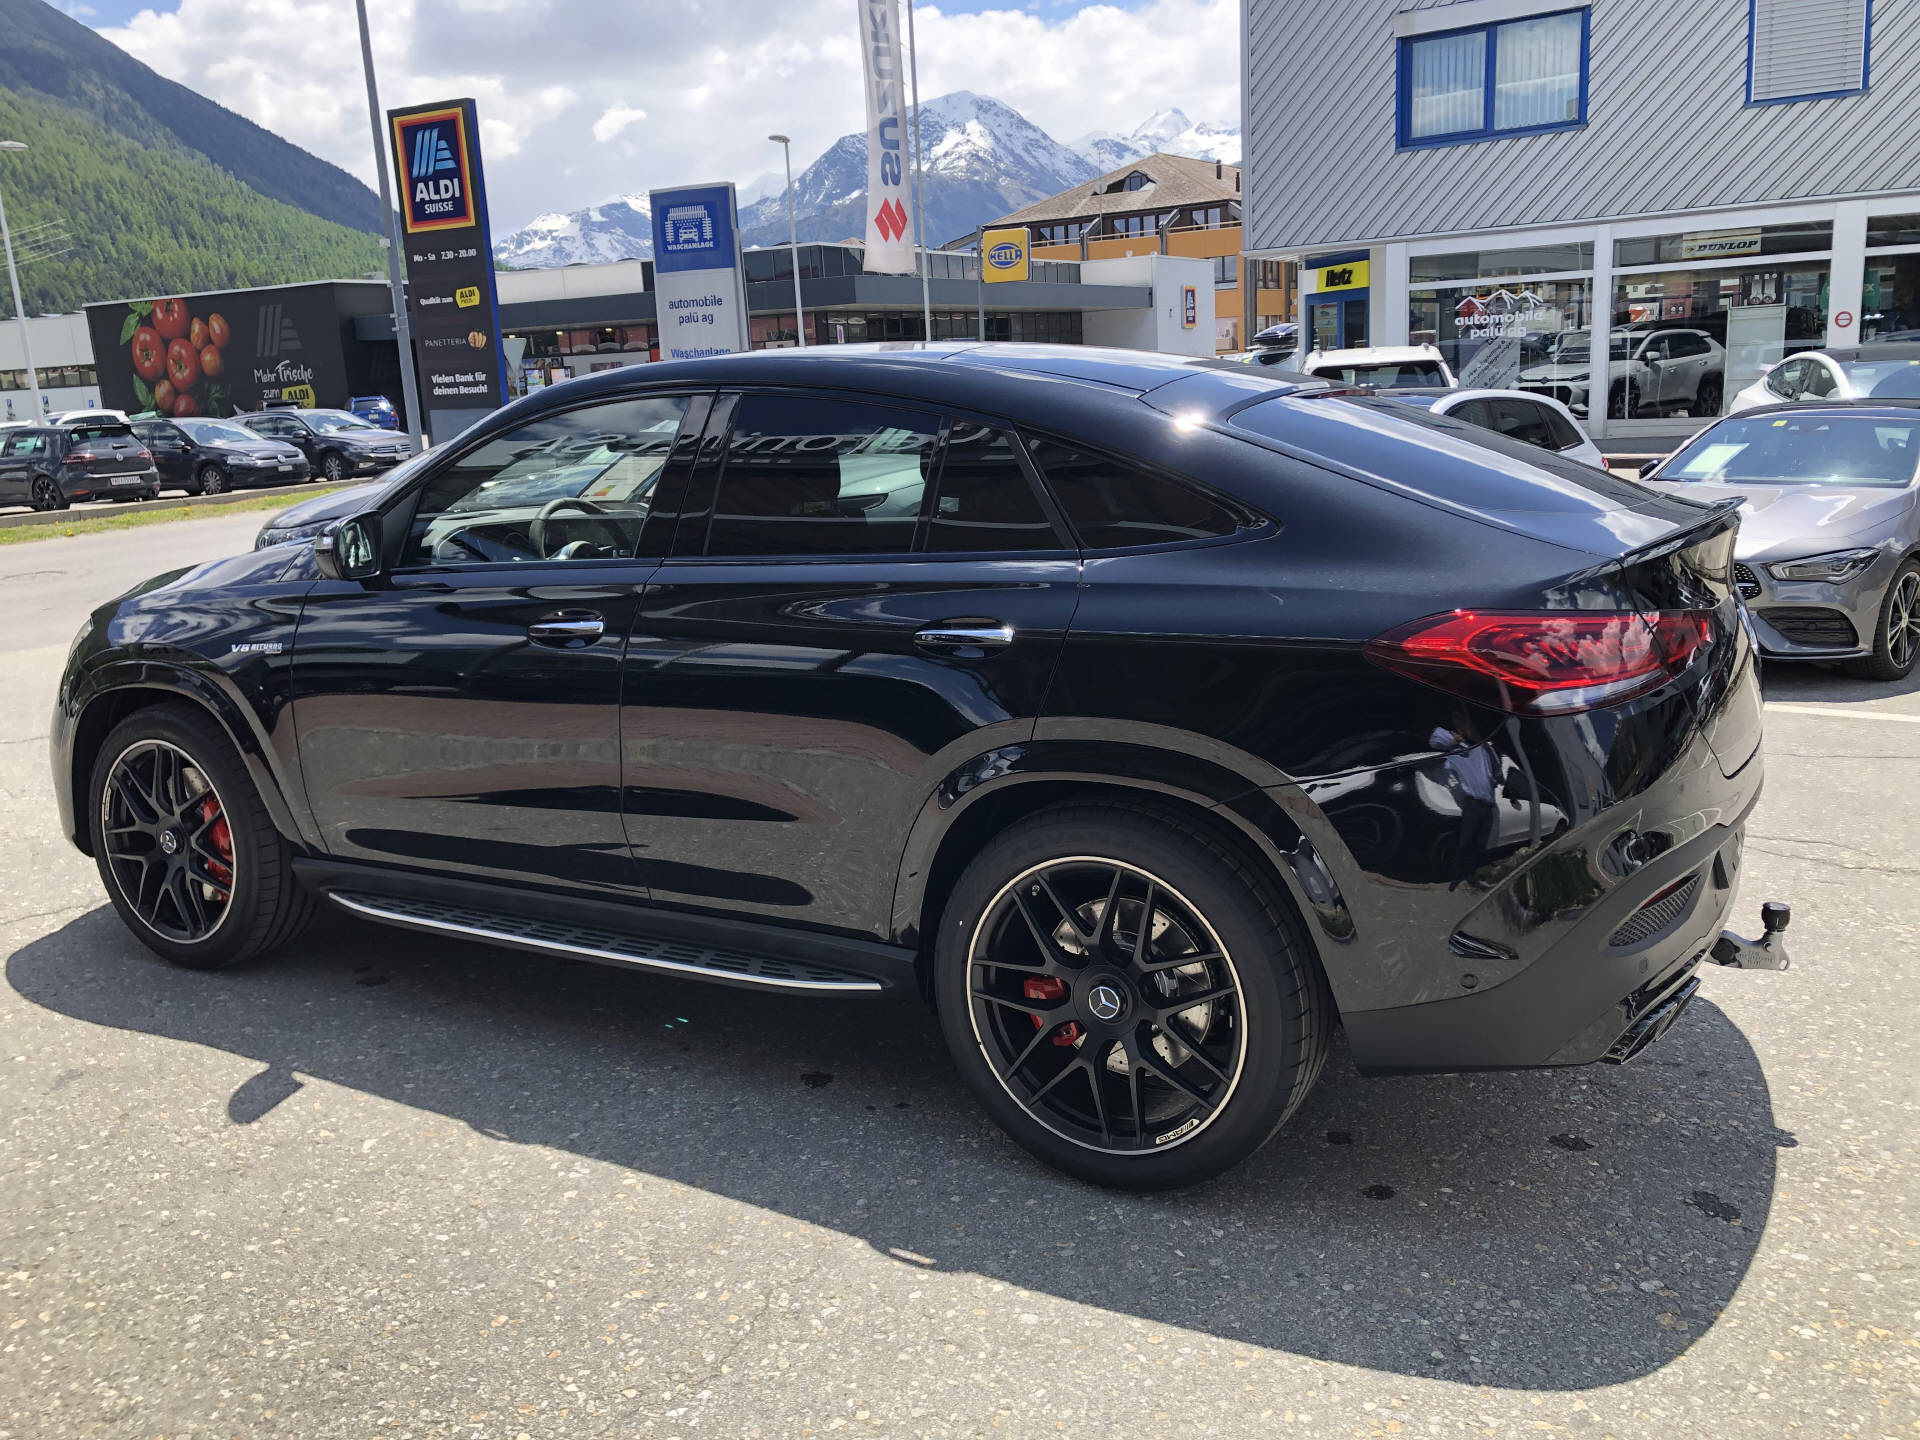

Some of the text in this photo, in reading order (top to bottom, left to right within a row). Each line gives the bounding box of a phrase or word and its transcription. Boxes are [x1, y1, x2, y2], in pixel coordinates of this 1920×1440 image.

[415, 178, 460, 202] ALDI
[424, 201, 454, 214] SUISSE
[667, 242, 714, 251] WASCHANLAGE
[1696, 240, 1759, 252] DUNLOP
[413, 254, 423, 262] Mo
[427, 253, 436, 261] Sa
[459, 249, 477, 258] 20.00
[990, 248, 1023, 261] HELLA
[460, 289, 476, 299] ALDI
[668, 295, 723, 311] automobile
[678, 313, 714, 327] palü ag
[1454, 310, 1543, 326] automobile
[1470, 326, 1527, 340] palü ag
[425, 338, 467, 347] PANETTERIA
[253, 360, 314, 384] Mehr Frische
[431, 371, 486, 383] Vielen Dank für
[262, 389, 310, 400] zum ALDI
[433, 384, 488, 395] deinen Besuch!
[231, 643, 250, 653] V8
